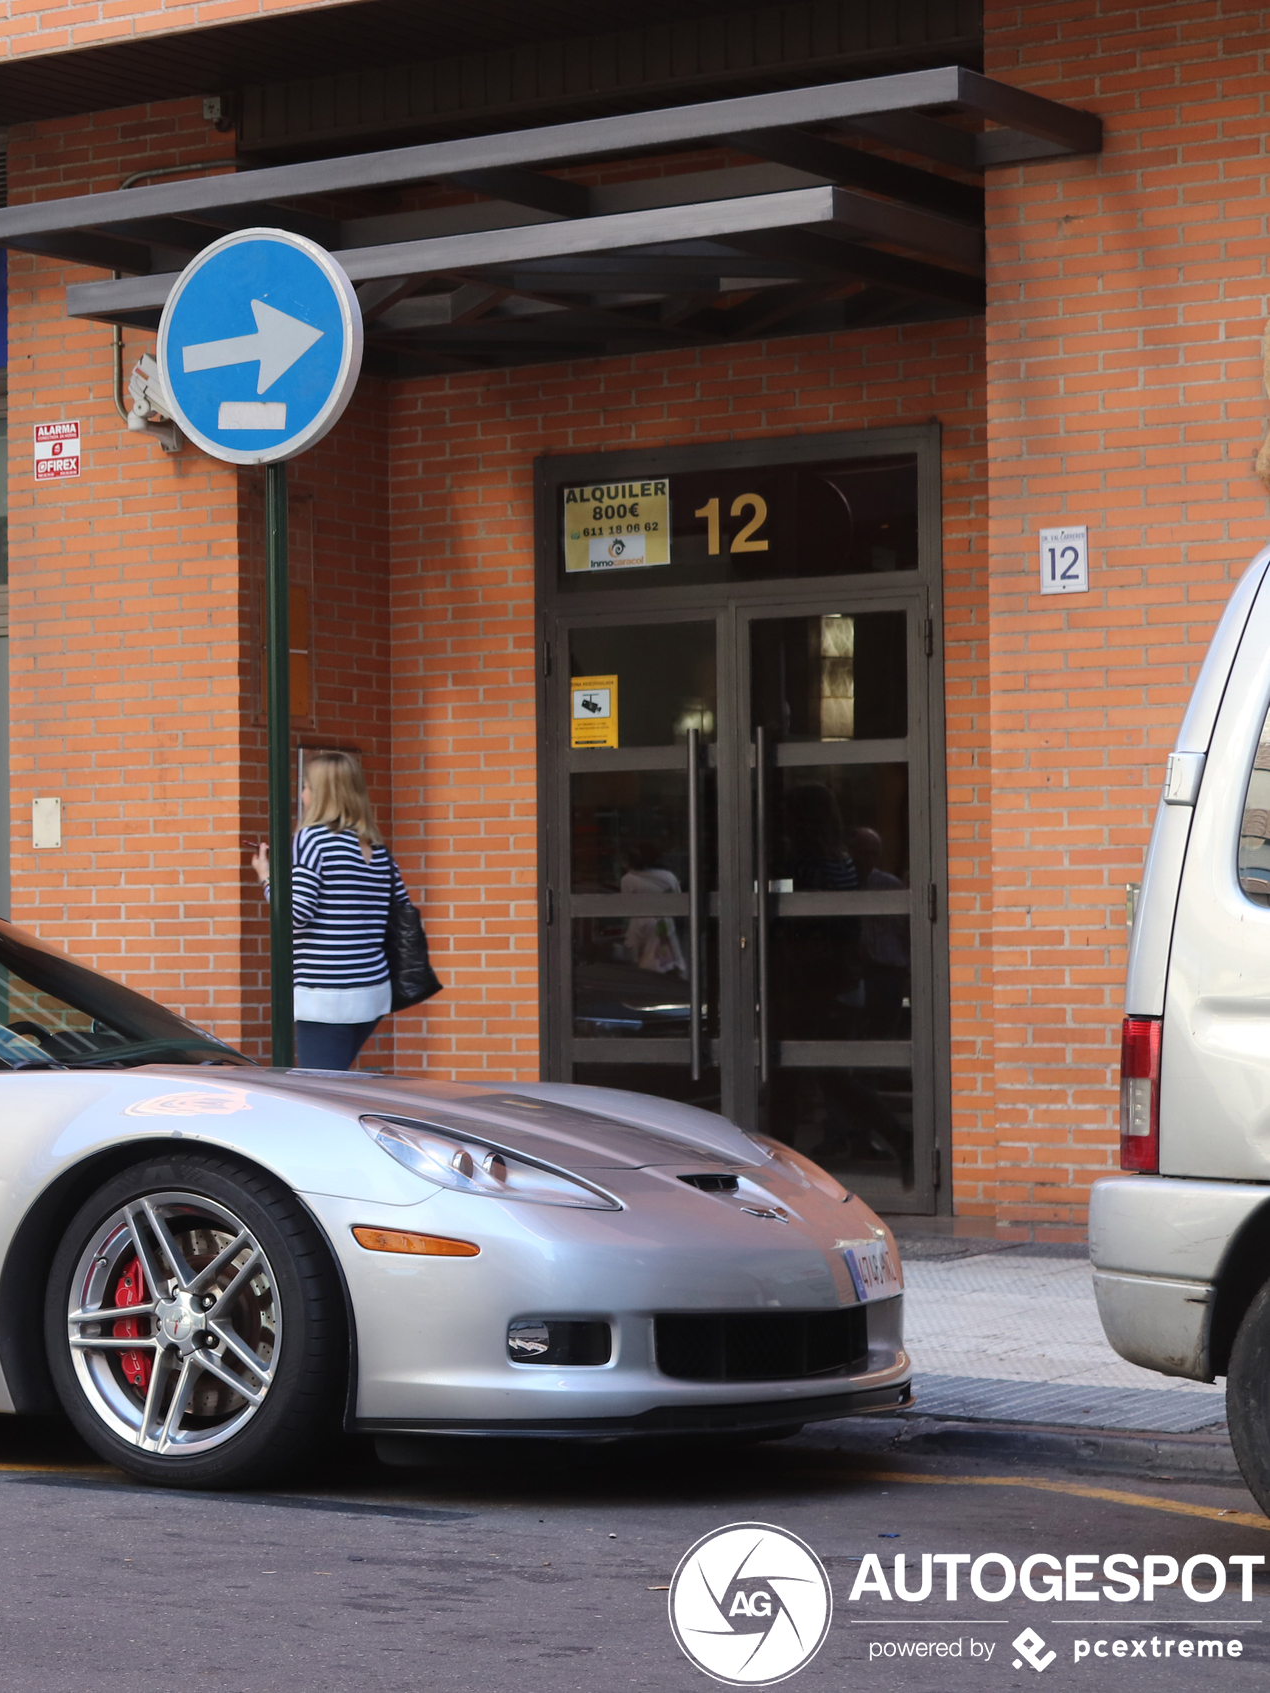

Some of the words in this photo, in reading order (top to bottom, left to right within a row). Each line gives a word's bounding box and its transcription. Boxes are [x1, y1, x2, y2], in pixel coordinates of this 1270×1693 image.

[38, 423, 76, 436] ALARMA
[566, 482, 666, 503] ALQUILER
[592, 502, 640, 521] 800€
[583, 527, 604, 537] 611
[609, 525, 623, 535] 18
[626, 523, 640, 533] 06
[644, 522, 659, 532] 62
[695, 492, 769, 555] 12
[590, 556, 644, 568] Inmocaracol
[1048, 546, 1080, 581] 12
